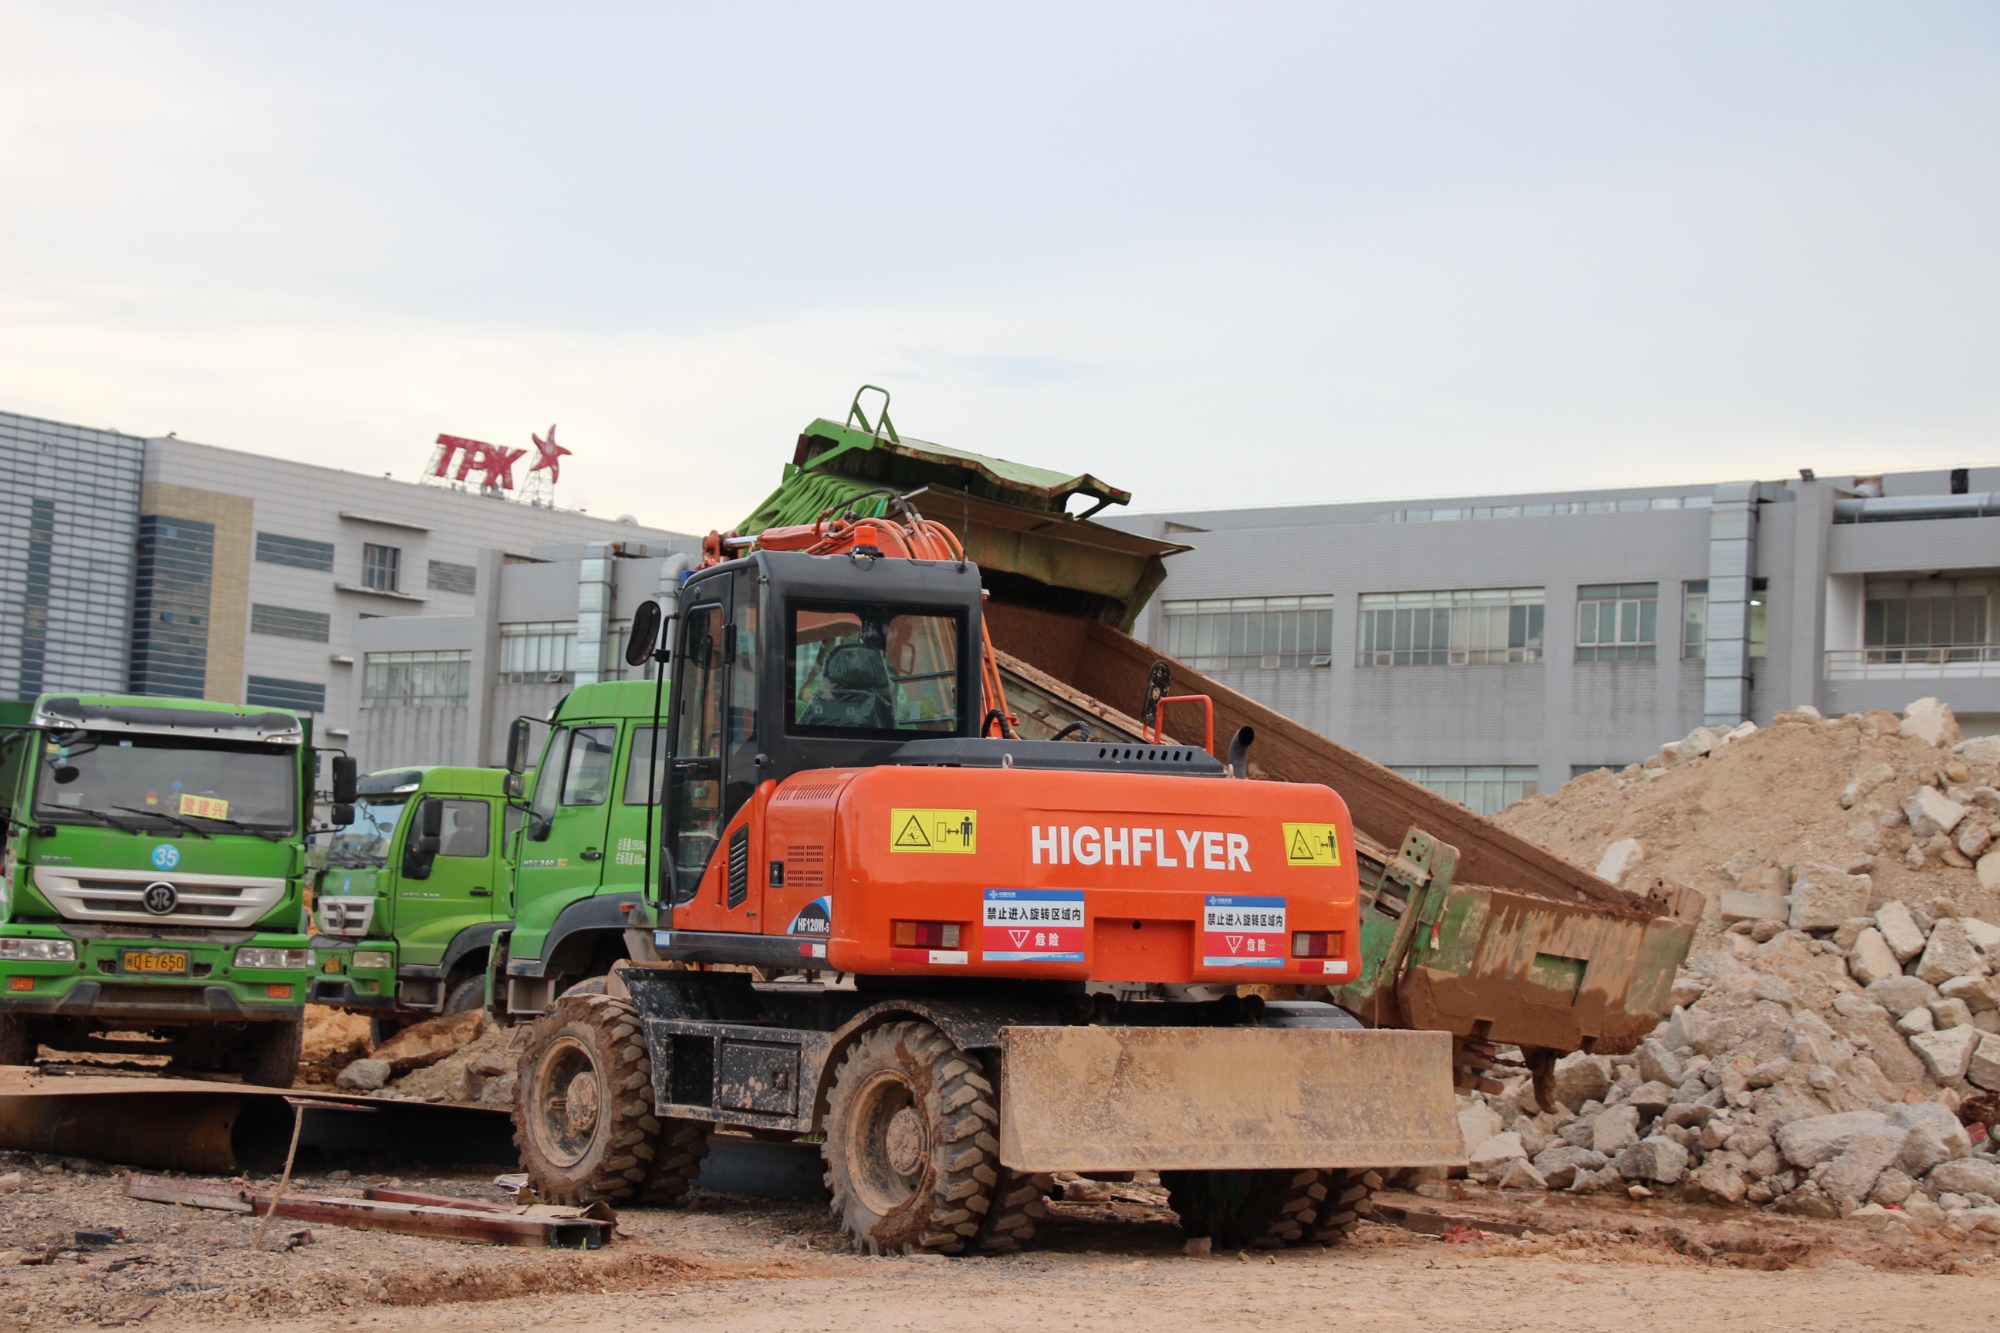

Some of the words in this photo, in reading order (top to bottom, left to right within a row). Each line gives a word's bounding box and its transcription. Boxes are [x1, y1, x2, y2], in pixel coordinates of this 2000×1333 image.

[435, 433, 528, 490] TPK
[1031, 825, 1252, 872] HIGHFLYER
[155, 848, 177, 867] 35
[987, 907, 1081, 921] 禁止进入旋转区域内
[1207, 912, 1283, 927] 禁止进入旋转区域内
[1035, 932, 1059, 947] 危险
[1247, 937, 1266, 952] 危险
